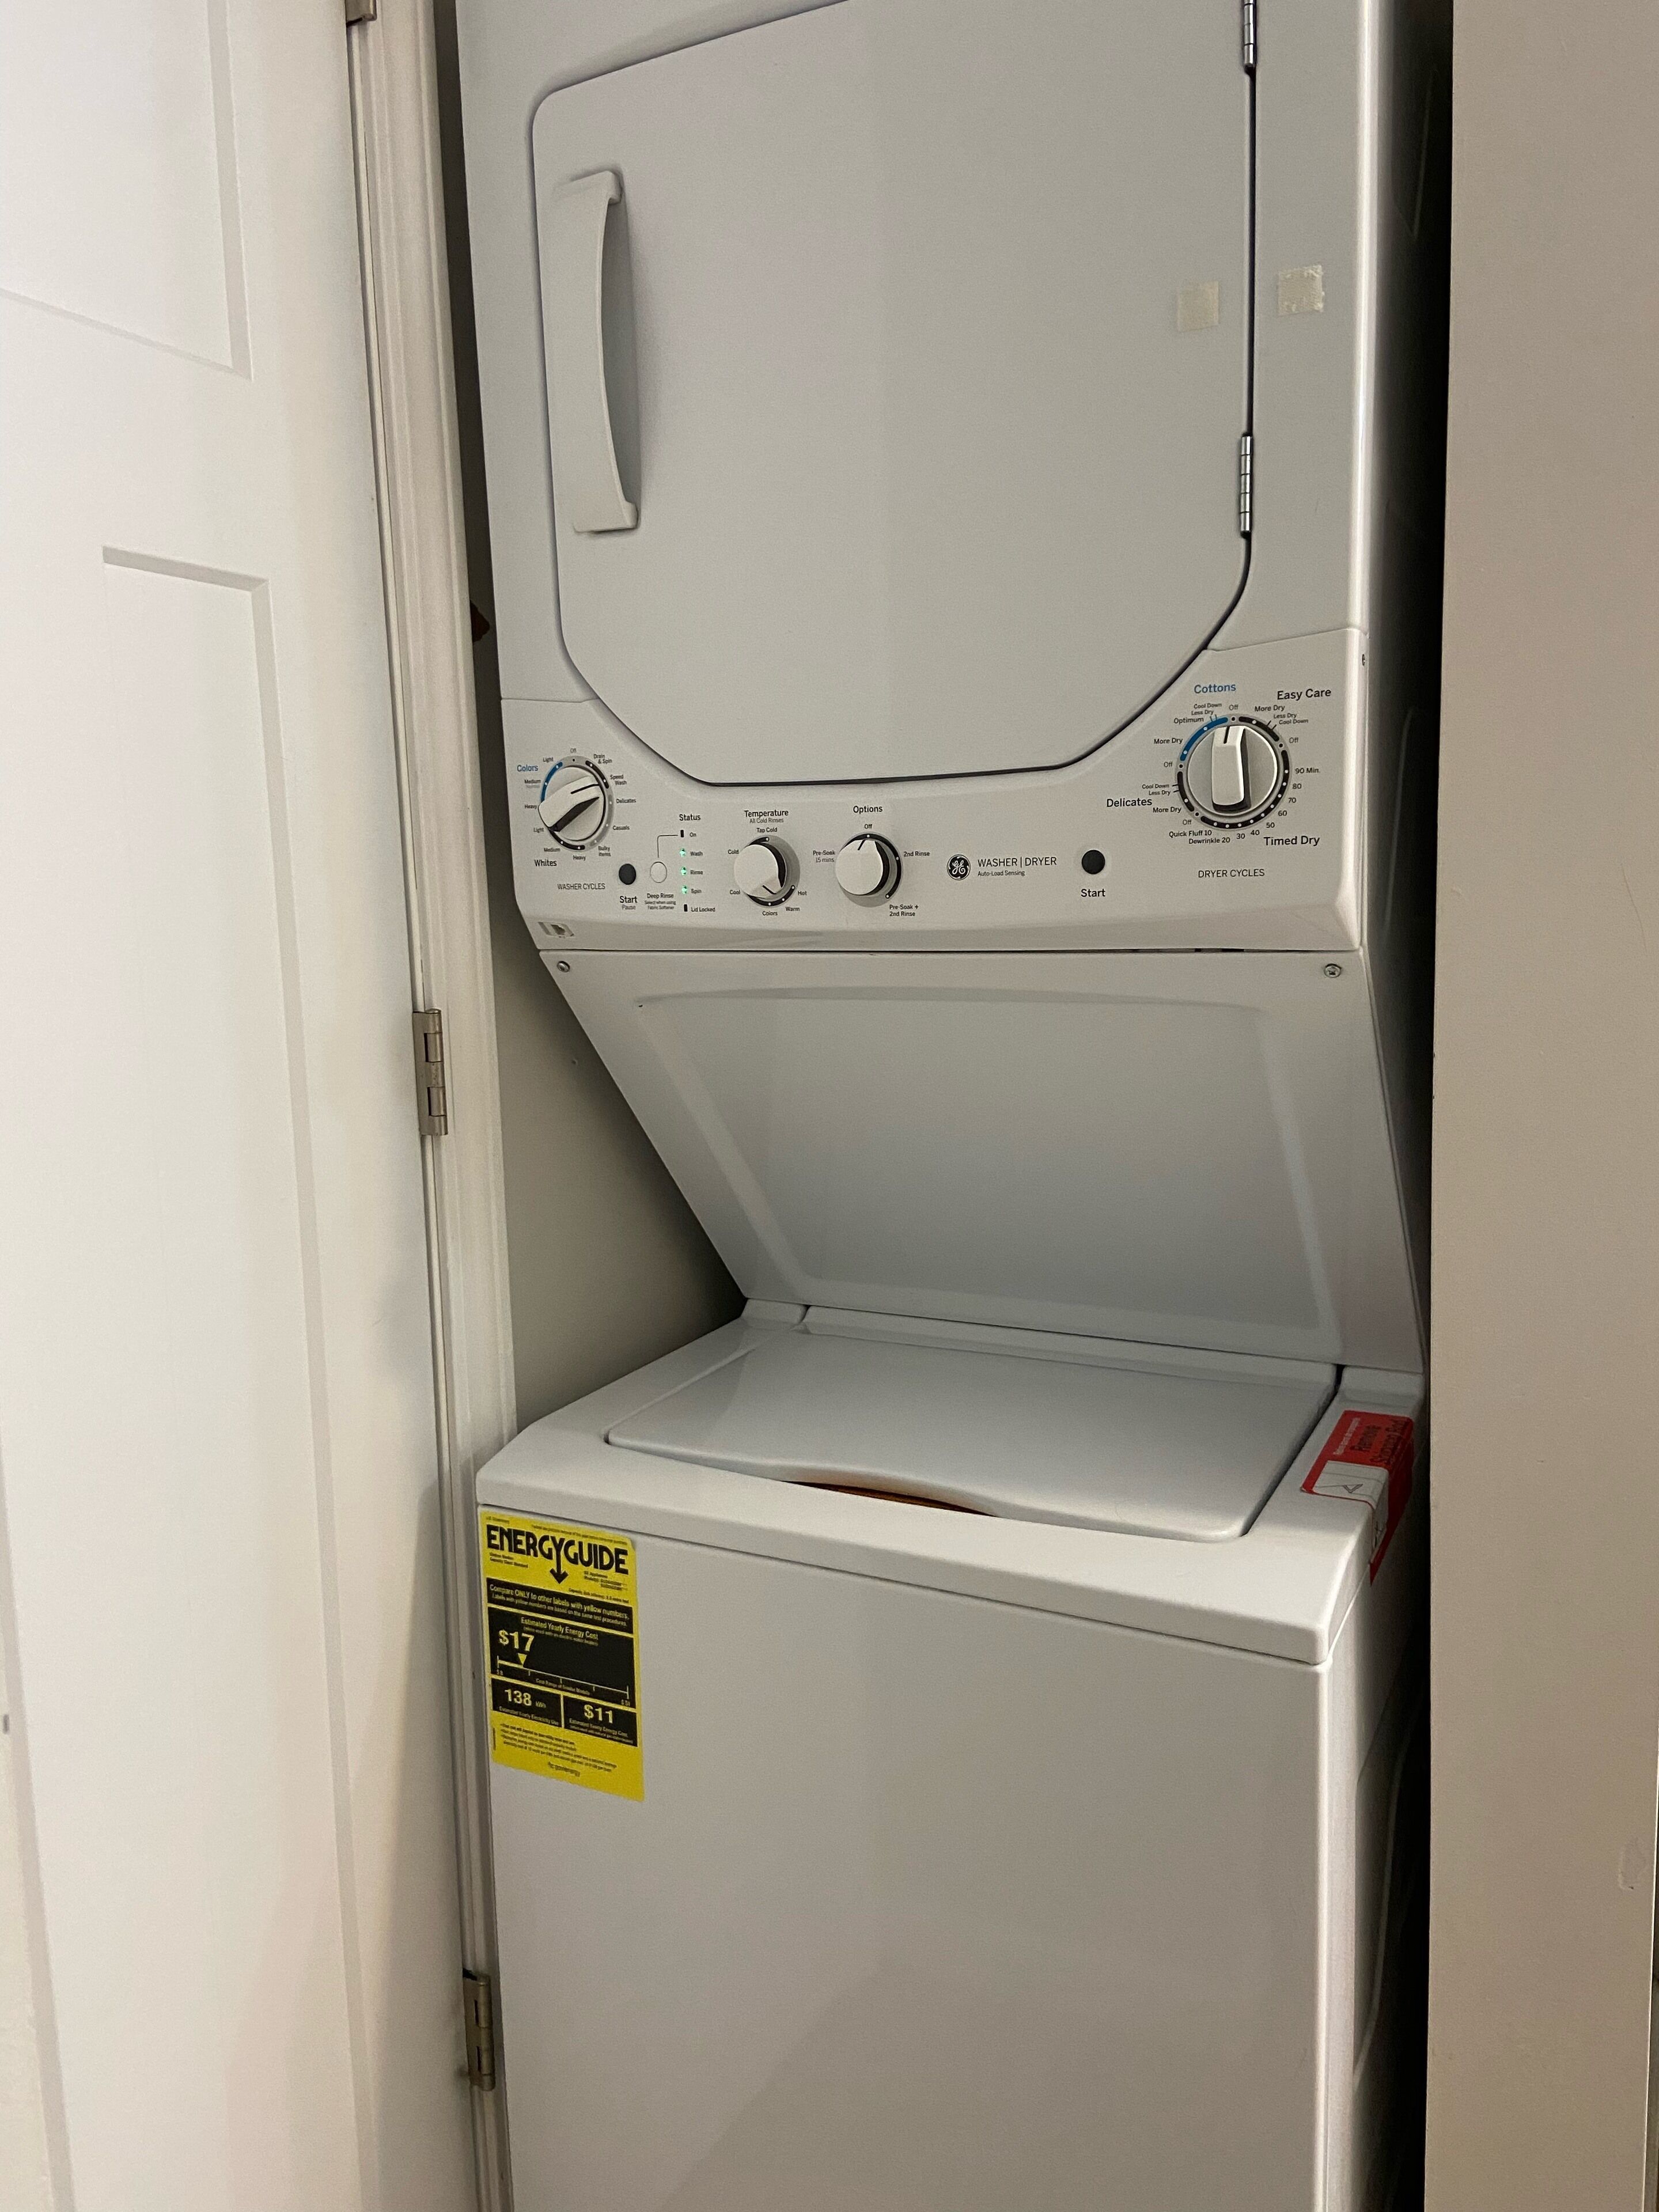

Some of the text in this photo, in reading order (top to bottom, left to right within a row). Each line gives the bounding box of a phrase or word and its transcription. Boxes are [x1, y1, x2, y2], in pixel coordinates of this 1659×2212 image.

[1194, 684, 1236, 694] Cottons
[1277, 688, 1331, 701] Easy Care
[1173, 717, 1204, 725] Optimum
[1107, 798, 1152, 808] Delicates
[744, 809, 789, 818] Temperature
[853, 805, 883, 814] Options
[1263, 836, 1320, 846] Timed Dry
[534, 859, 557, 867] Whites
[978, 857, 1058, 868] WASHER DRYER
[1198, 869, 1265, 878] DRYER CYCLES
[1081, 888, 1106, 897] Start
[487, 1524, 629, 1575] ENERGYGUIDE
[490, 1584, 514, 1595] Compare
[514, 1589, 530, 1599] ONLY
[537, 1594, 552, 1603] other
[553, 1597, 570, 1607] labels
[571, 1601, 583, 1609] with
[584, 1604, 602, 1613] yellow
[521, 1616, 547, 1628] Estimated
[547, 1622, 565, 1634] Yearly
[565, 1626, 584, 1638] Energy
[585, 1631, 599, 1641] Cost
[498, 1629, 535, 1652] $17
[504, 1688, 532, 1706] 138
[584, 1704, 613, 1724] $11
